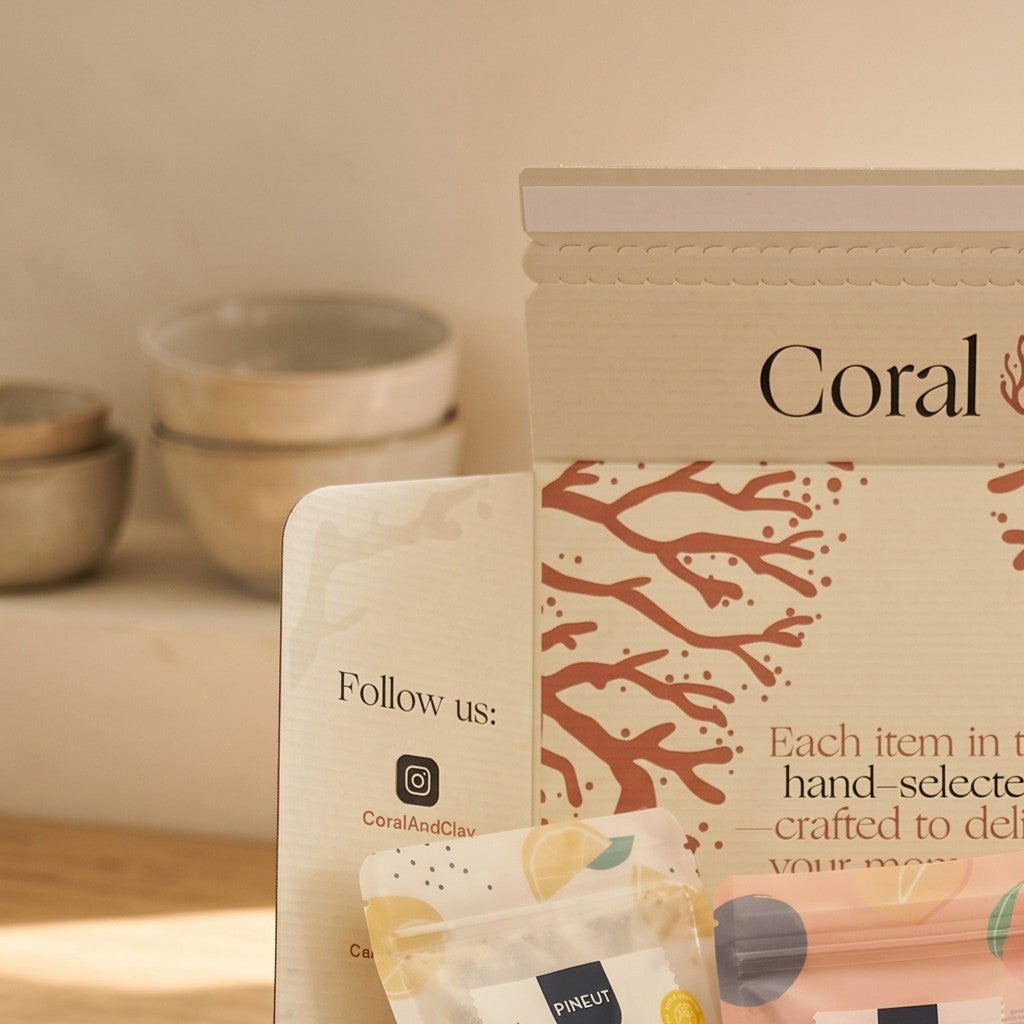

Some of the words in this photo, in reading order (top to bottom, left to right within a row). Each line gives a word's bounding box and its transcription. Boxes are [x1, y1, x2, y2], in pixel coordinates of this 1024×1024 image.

[759, 333, 981, 418] Coral
[338, 670, 445, 717] Follow
[455, 697, 497, 726] us:
[769, 723, 861, 758] Each
[875, 725, 953, 758] item
[968, 726, 1001, 758] in
[915, 811, 951, 840] to
[553, 989, 612, 1016] PINEUT
